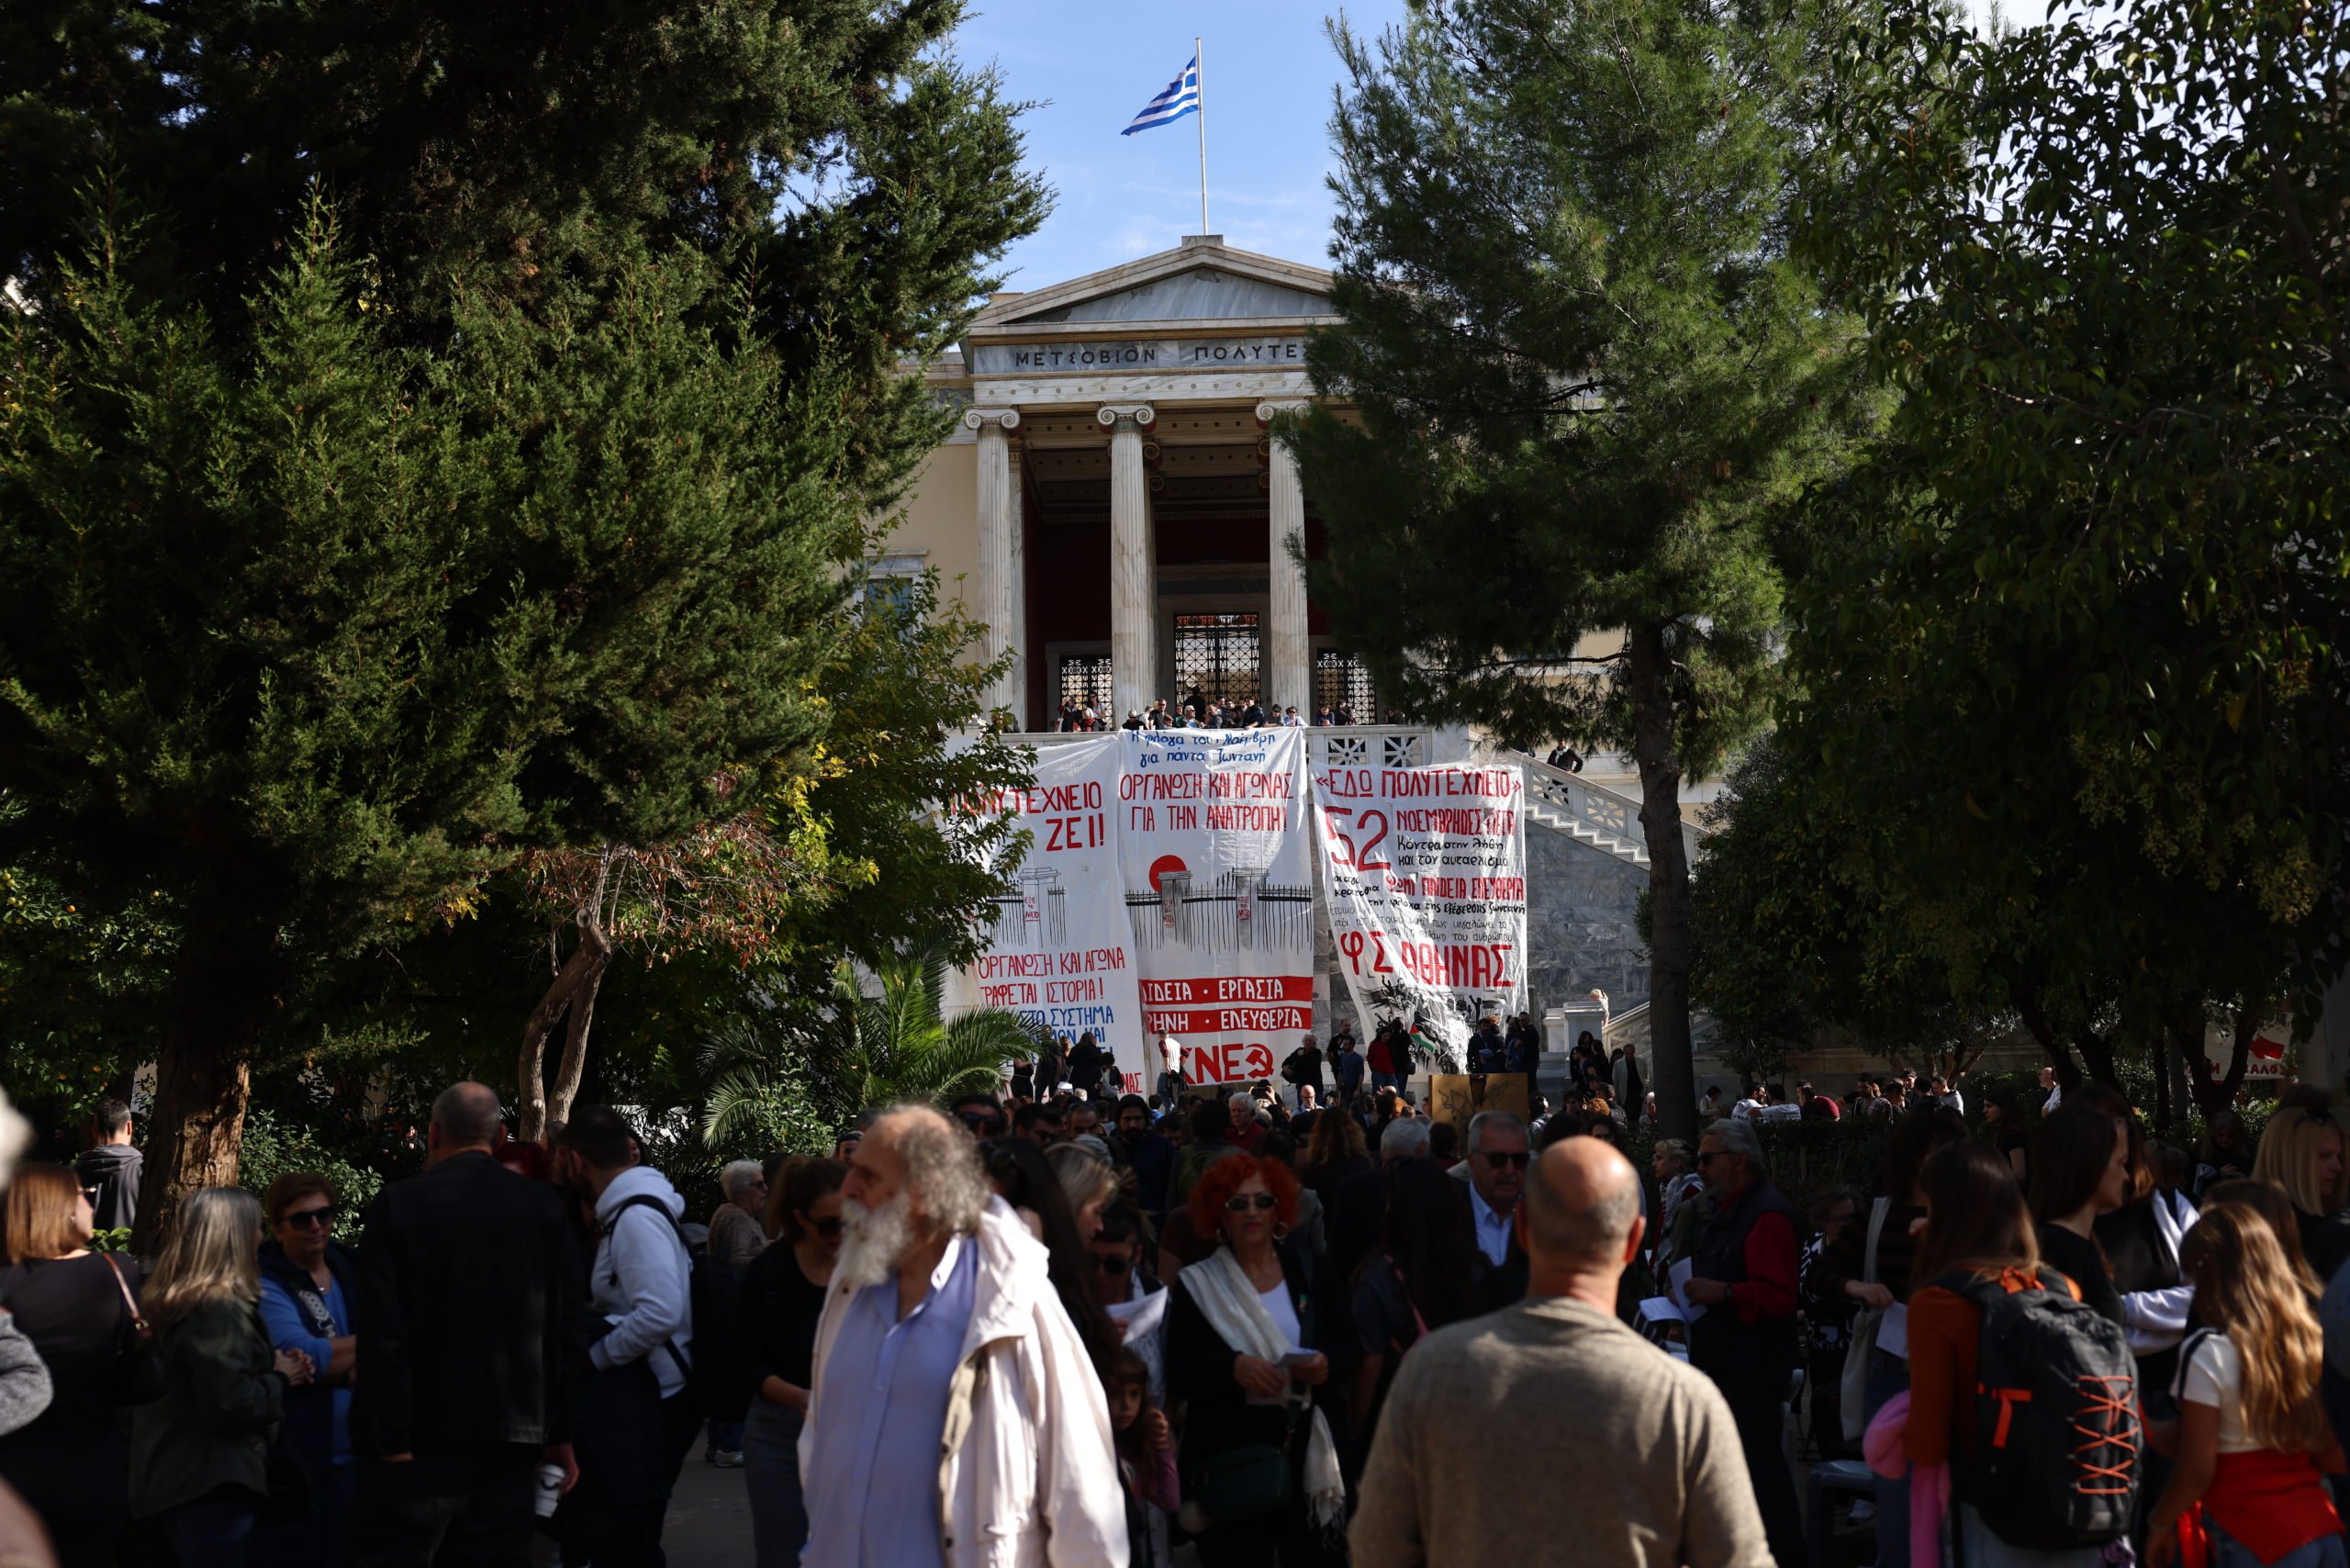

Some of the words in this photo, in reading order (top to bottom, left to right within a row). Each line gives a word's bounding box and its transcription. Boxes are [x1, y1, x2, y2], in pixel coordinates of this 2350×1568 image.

[1140, 752, 1159, 768] για
[1167, 747, 1206, 762] πάντα
[1217, 748, 1266, 764] ζωντανή
[1120, 773, 1203, 801] ΟΡΓΑΝΩΣΗ
[1209, 772, 1231, 799] ΚΑΙ
[1235, 772, 1294, 800] ΑΓΩΝΑΣ
[1131, 806, 1155, 832] ΓΙΑ
[1166, 805, 1197, 831] ΤΗΝ
[1206, 805, 1287, 832] ΑΝΑΤΡΟΠΗ!
[1046, 812, 1104, 852] ΖΕΙ!
[1325, 806, 1392, 872] 52
[1397, 835, 1442, 851] Κόντρα
[1443, 840, 1469, 850] στην
[1472, 838, 1504, 851] λήθη
[1398, 857, 1415, 867] και
[1418, 856, 1438, 865] τον
[1442, 855, 1508, 868] αυταρχισμό
[1421, 878, 1467, 900] ΠΑΙΔΕΙΑ
[1471, 878, 1525, 901] ΕΛΕΥΘΕΡΙΑ
[1488, 902, 1526, 914] ζωντανή
[979, 953, 1054, 979] ΟΡΓΑΝΩΣΗ
[1059, 951, 1081, 975] ΚΑΙ
[1084, 946, 1125, 973] ΑΓΩΝΑ
[1401, 942, 1514, 989] ΑΘΗΝΑΣ
[1218, 978, 1284, 1001] ΕΡΓΑΣΙΑ
[1050, 1005, 1114, 1027] ΣΥΣΤΗΜΑ
[1220, 1008, 1303, 1030] ΕΛΕΥΘΕΡΙΑ
